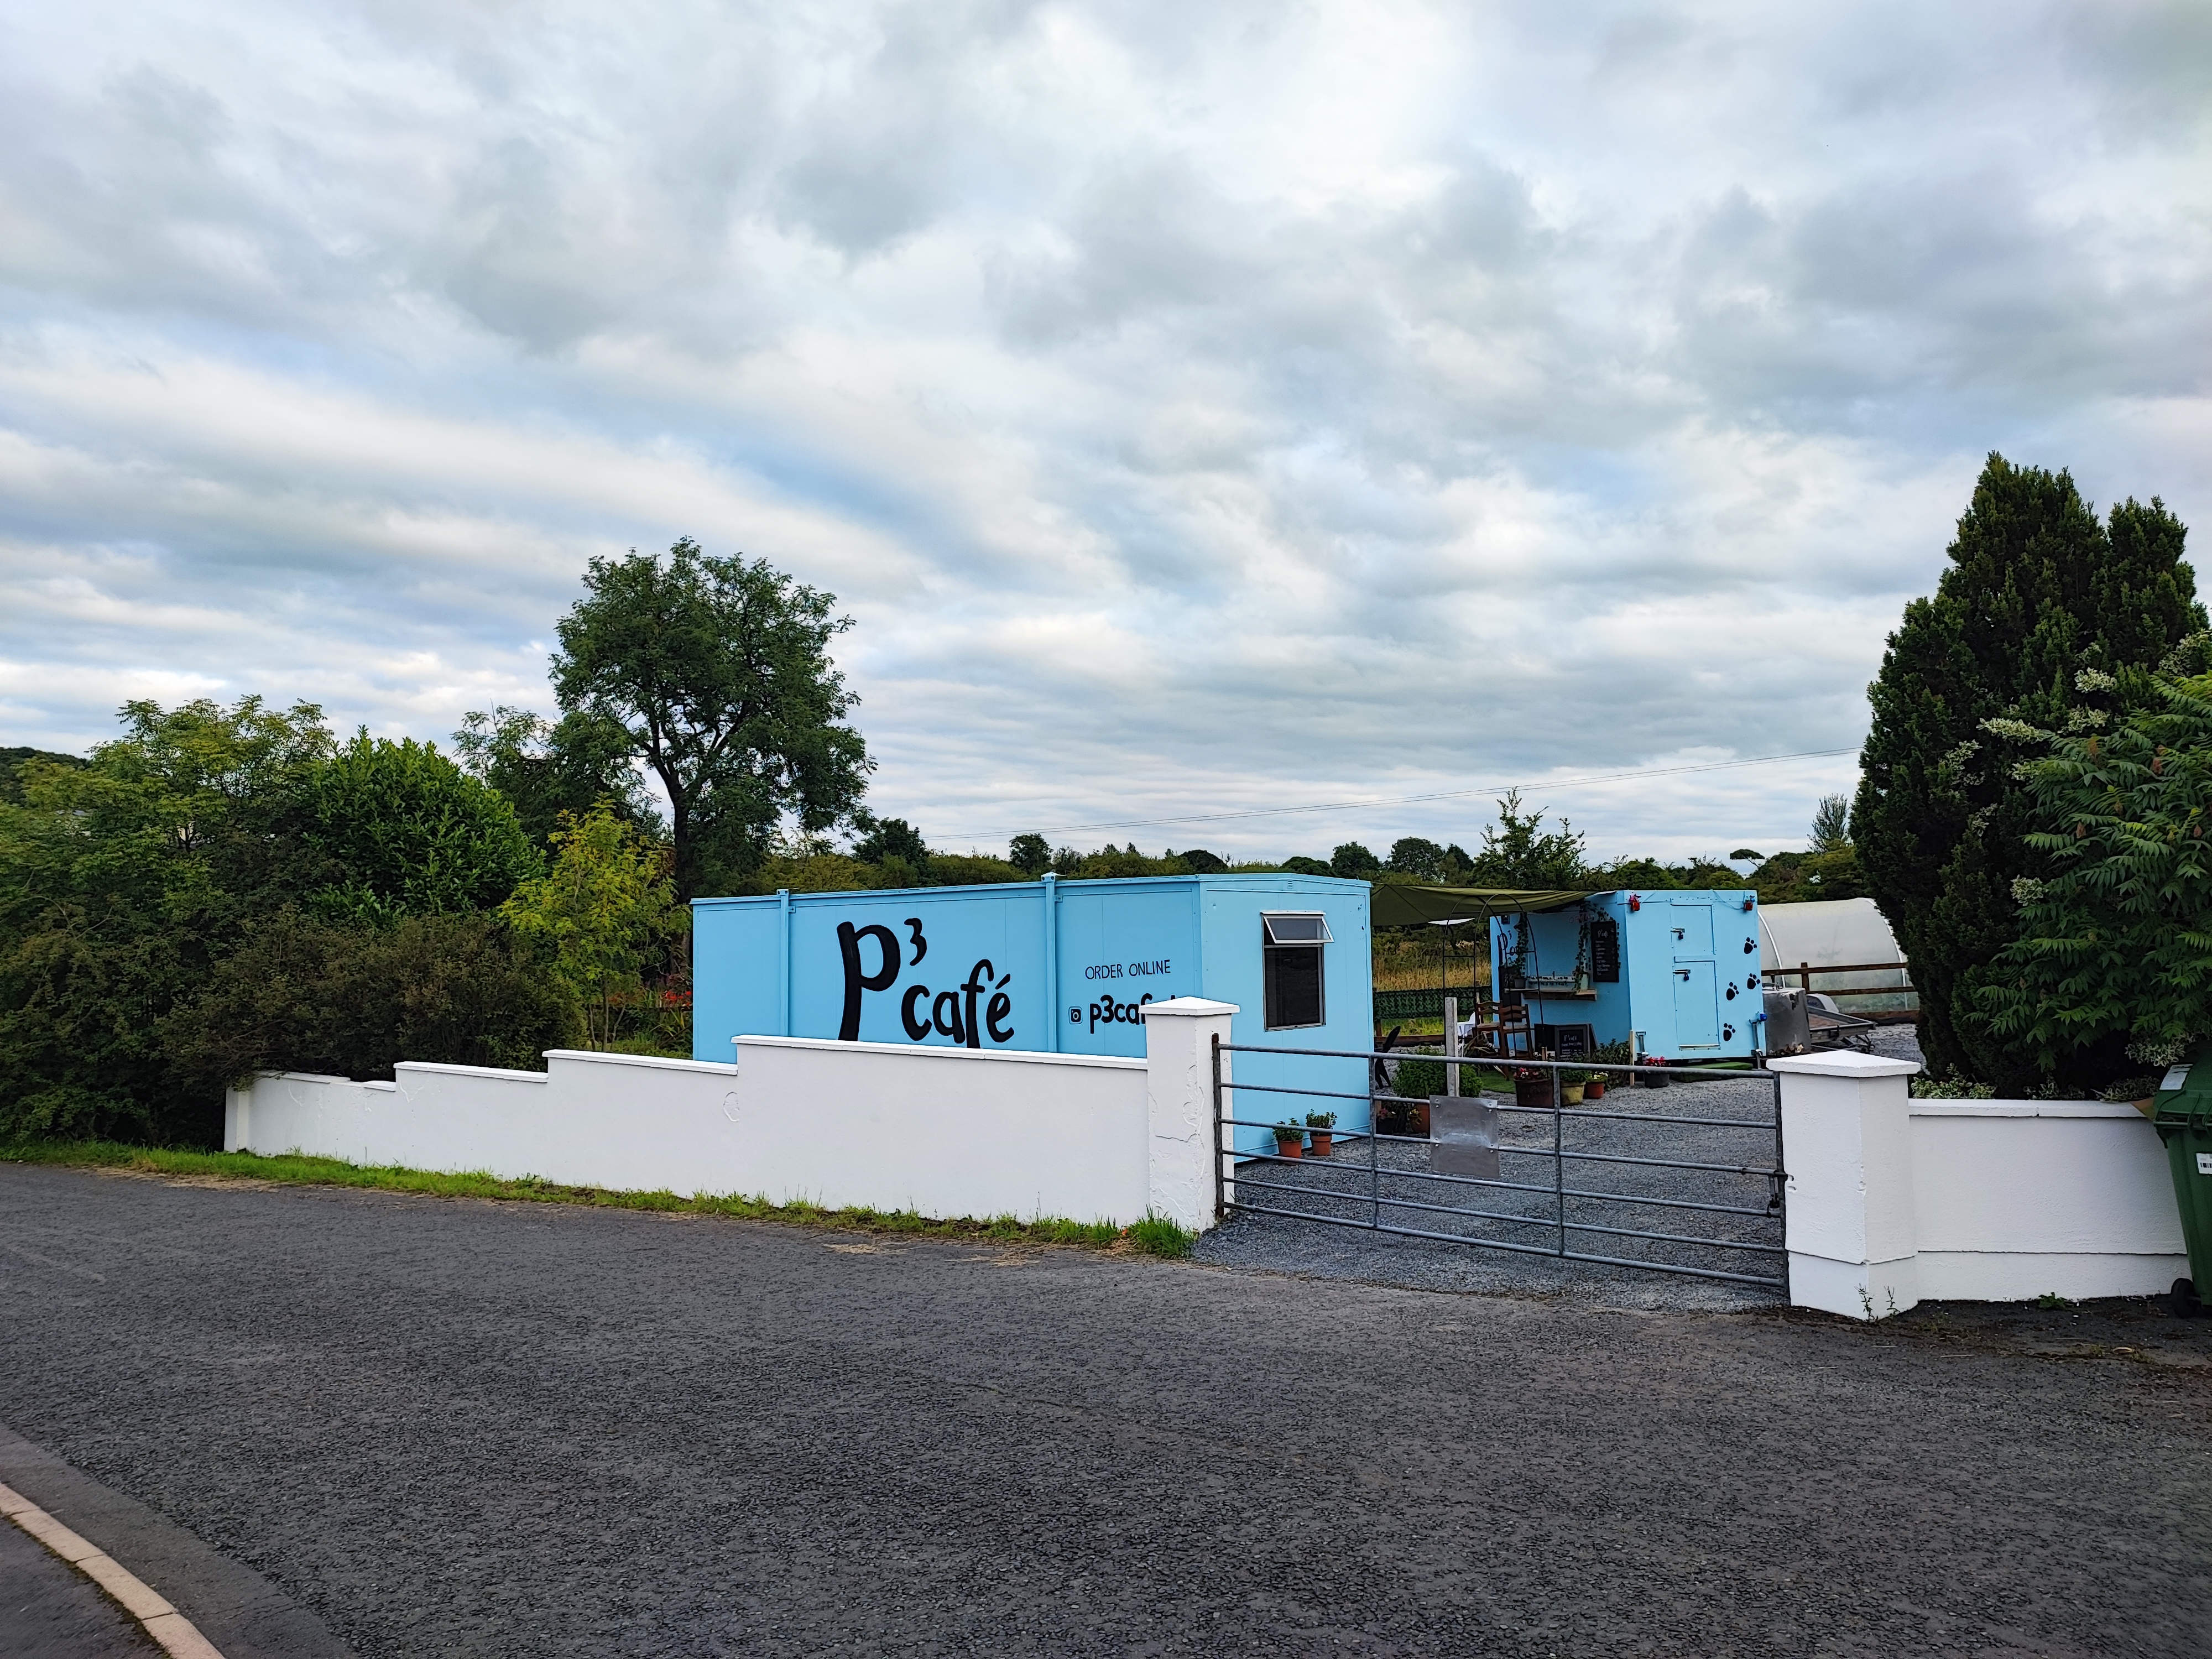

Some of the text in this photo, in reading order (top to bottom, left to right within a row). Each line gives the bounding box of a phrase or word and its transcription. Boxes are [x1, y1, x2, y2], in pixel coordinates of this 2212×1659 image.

[1085, 959, 1171, 980] ORDER ONLINE
[901, 959, 1015, 1048] café
[1089, 993, 1176, 1035] p3caf
